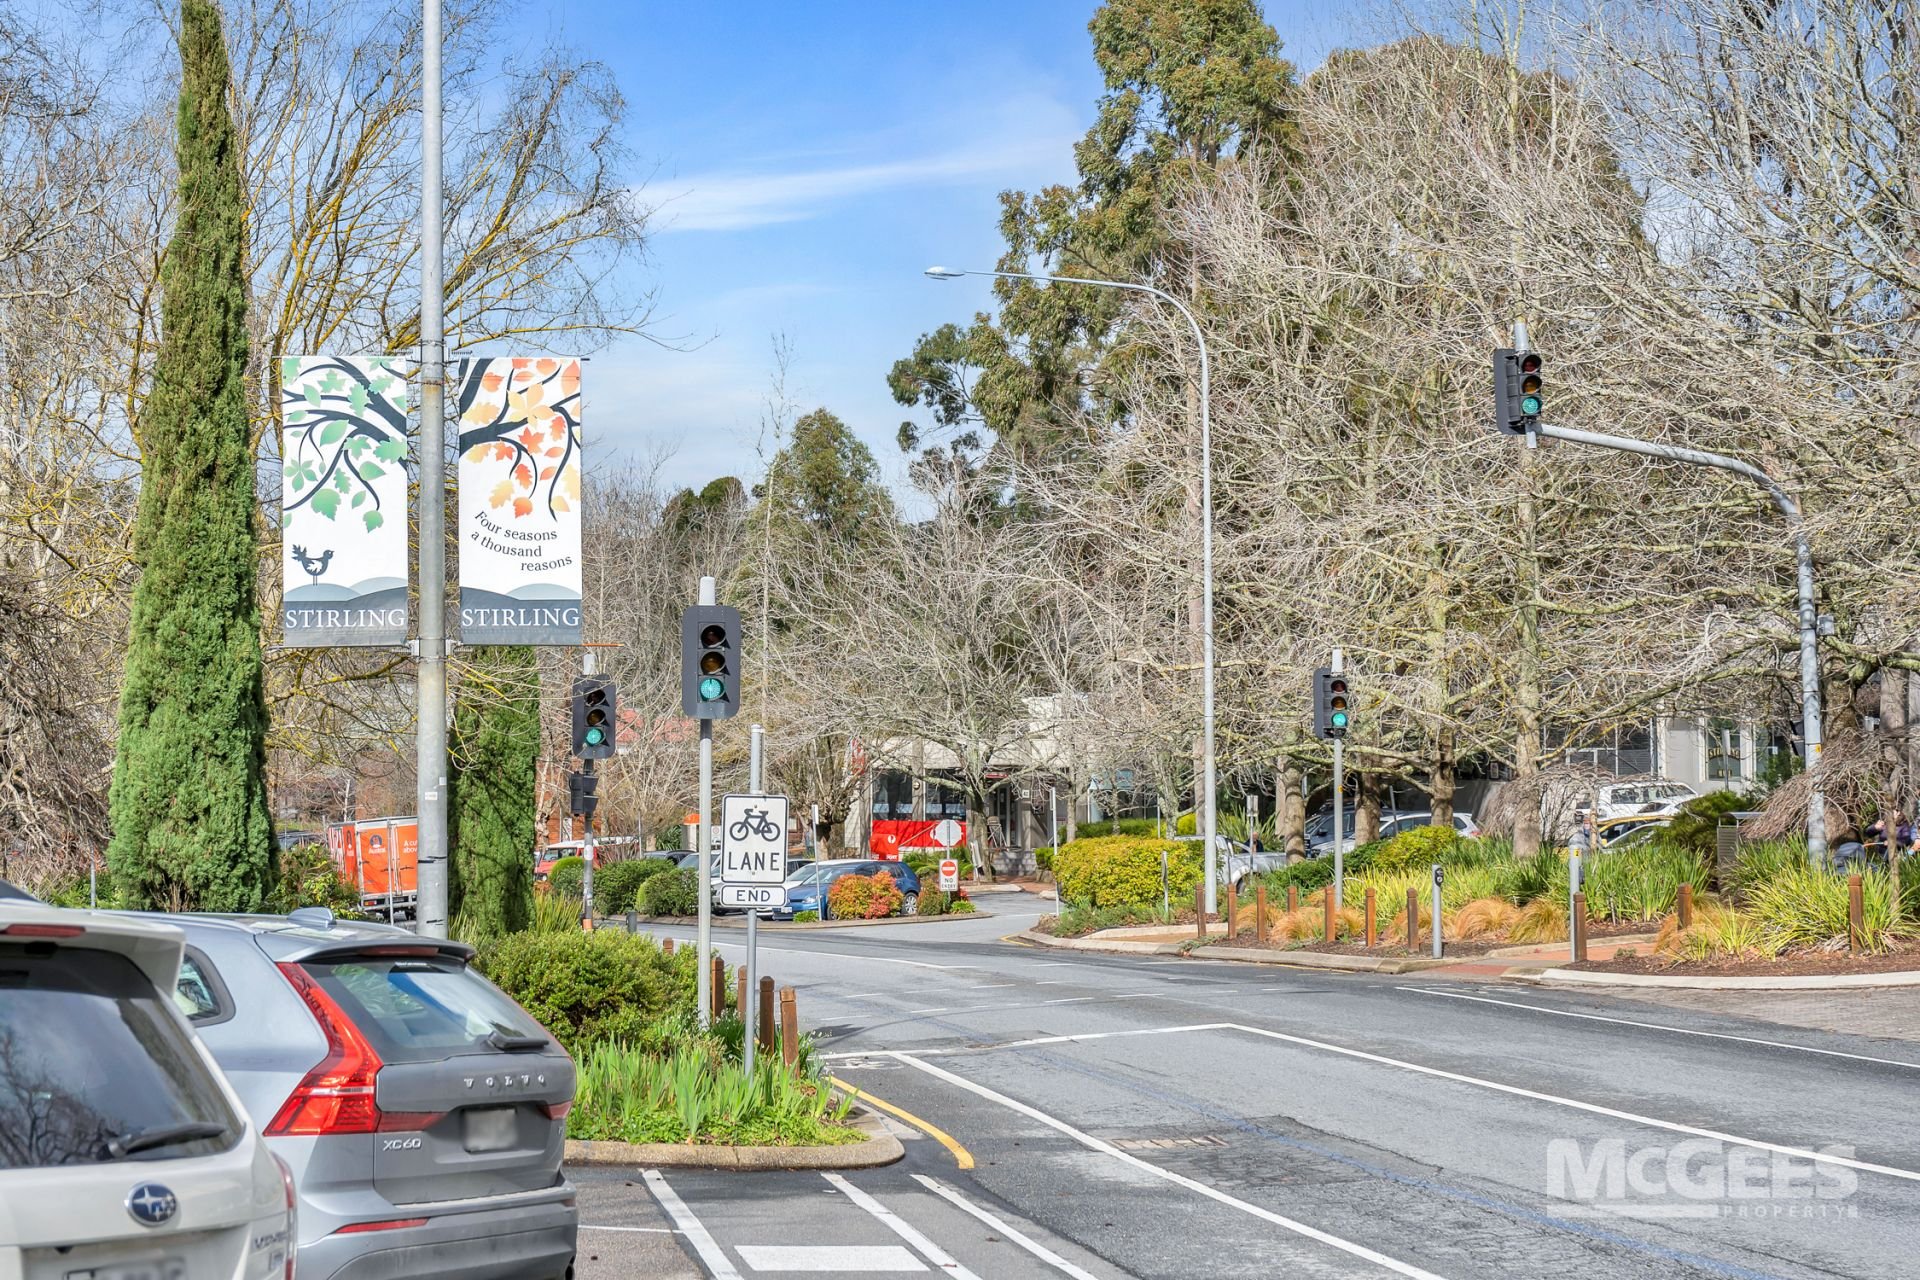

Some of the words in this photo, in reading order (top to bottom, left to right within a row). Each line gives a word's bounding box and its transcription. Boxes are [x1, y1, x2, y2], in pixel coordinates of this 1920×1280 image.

[474, 510, 502, 537] Four
[503, 527, 558, 541] seasons
[470, 531, 480, 540] a
[480, 537, 542, 557] thousand
[520, 556, 573, 572] reasons
[285, 609, 406, 629] STIRLING
[461, 607, 580, 628] STIRLING
[728, 851, 780, 871] LANE
[736, 889, 771, 902] END
[463, 1074, 545, 1088] VOLVO
[383, 1137, 423, 1152] XC60
